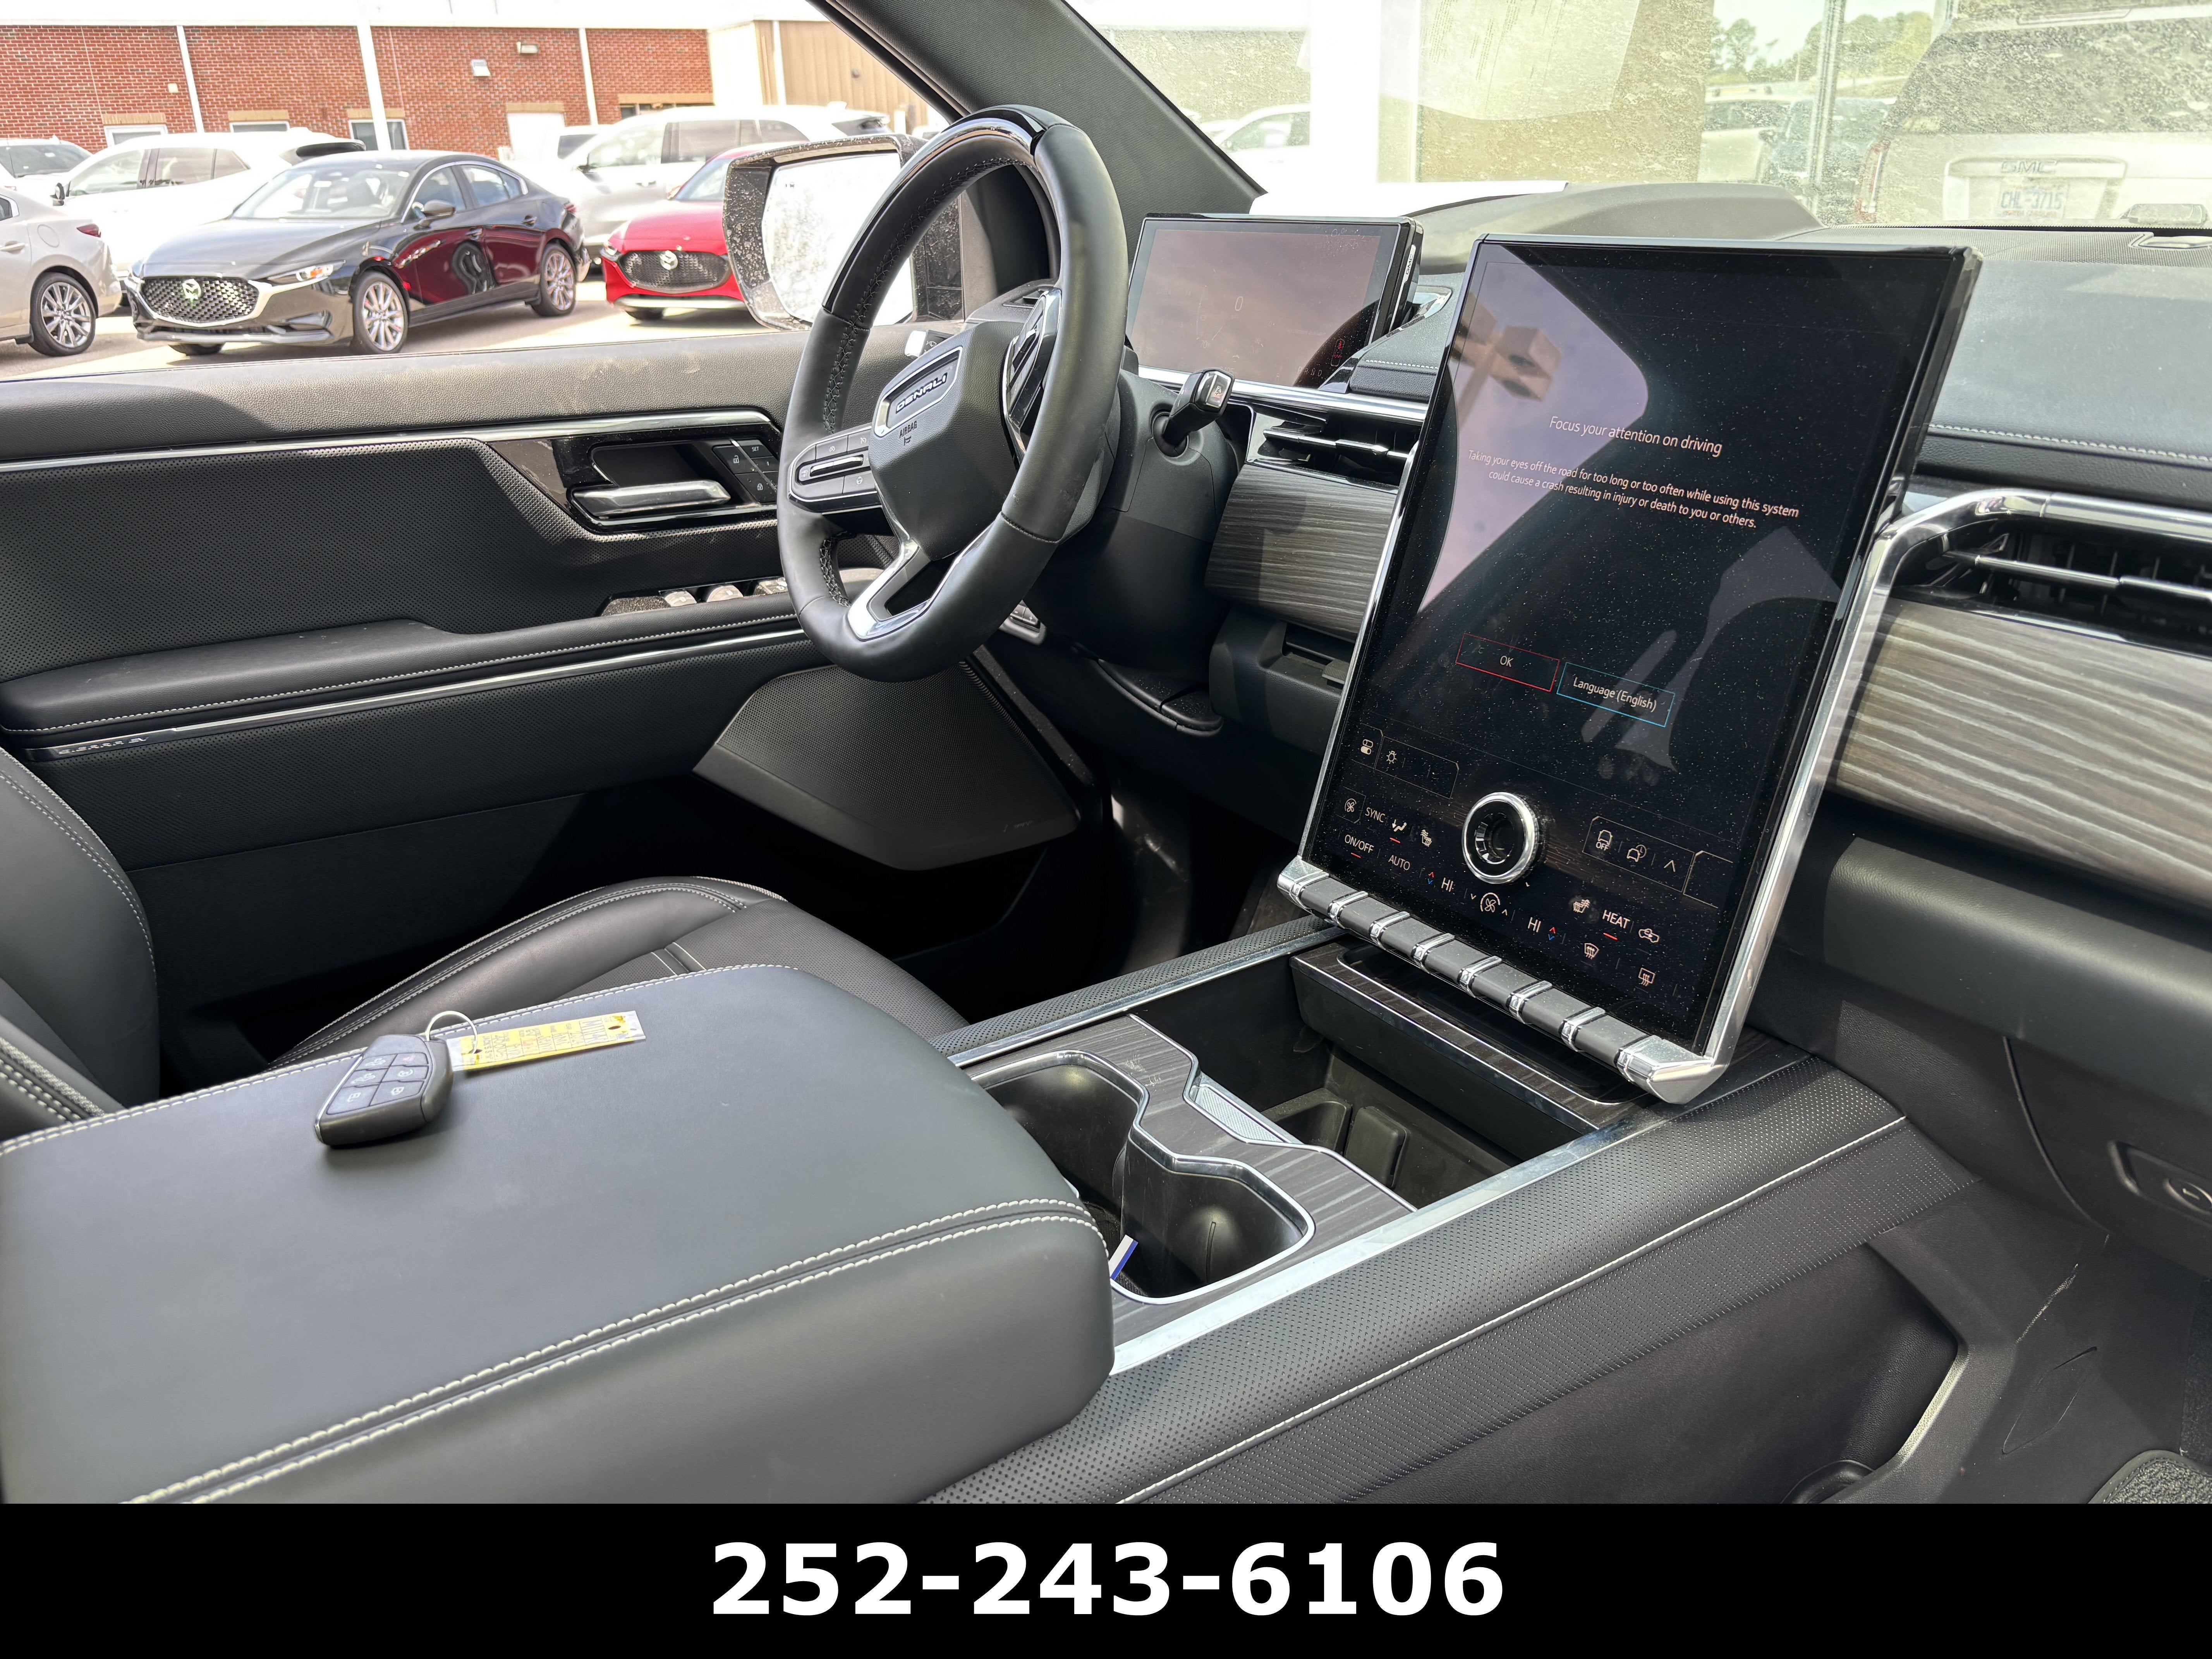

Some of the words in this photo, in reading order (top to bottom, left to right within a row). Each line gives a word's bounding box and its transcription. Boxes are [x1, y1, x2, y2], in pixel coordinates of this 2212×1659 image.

[2001, 160, 2058, 173] GMC
[1406, 253, 1414, 275] GMC
[1235, 296, 1243, 311] 0
[895, 372, 948, 414] DENALI
[899, 421, 917, 438] AIRBAG
[1549, 416, 1580, 432] Focus
[1580, 424, 1608, 436] your
[1608, 427, 1660, 444] attention
[1662, 435, 1678, 447] on
[1680, 435, 1723, 458] driving
[1468, 450, 1491, 465] Taking
[1492, 457, 1510, 466] your
[1511, 460, 1528, 470] eyes
[1530, 461, 1544, 471] off
[1544, 463, 1557, 474] the
[1558, 467, 1578, 477] road
[1580, 469, 1592, 480] for
[1593, 472, 1607, 483] too
[1609, 474, 1629, 489] long
[1630, 481, 1641, 489] or
[1642, 481, 1657, 492] too
[1659, 483, 1684, 497] often
[1686, 488, 1711, 502] while
[1713, 495, 1740, 510] using
[1741, 497, 1760, 511] this
[1762, 504, 1799, 517] system
[1489, 471, 1510, 481] could
[1511, 475, 1534, 486] cause
[1542, 481, 1564, 491] crash
[1565, 485, 1602, 501] resulting
[1603, 490, 1611, 500] in
[1613, 491, 1638, 507] injury
[1638, 499, 1649, 508] or
[1650, 498, 1677, 512] death
[1678, 504, 1689, 515] to
[1689, 507, 1708, 519] you
[1710, 512, 1721, 521] or
[1722, 513, 1756, 528] others.
[1500, 655, 1513, 668] OK
[1573, 677, 1615, 699] Language
[1616, 692, 1657, 713] (English)
[1365, 807, 1386, 823] SYNC
[1344, 834, 1374, 854] ON/OFF
[1595, 842, 1610, 851] OFF
[1388, 855, 1410, 871] AUTO
[1441, 877, 1453, 892] HI
[1528, 917, 1541, 933] HI
[1602, 910, 1630, 929] HEAT
